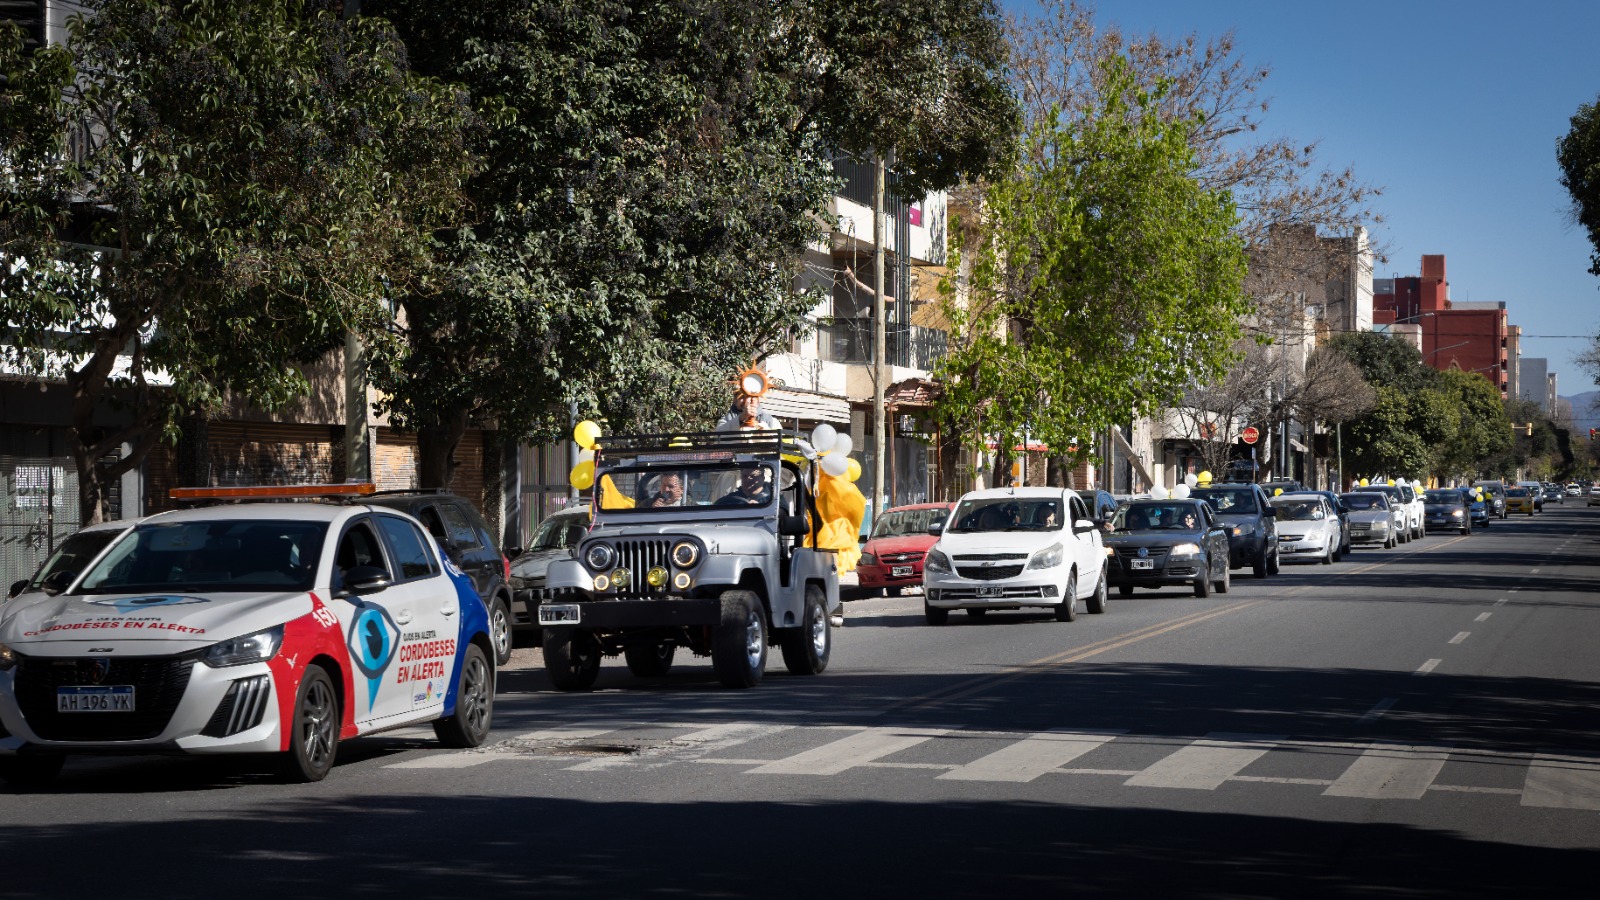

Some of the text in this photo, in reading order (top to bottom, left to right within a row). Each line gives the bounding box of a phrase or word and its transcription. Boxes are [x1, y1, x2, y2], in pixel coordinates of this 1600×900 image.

[312, 606, 337, 628] 150
[23, 621, 206, 637] CORDOBESES EN ALERTA
[403, 632, 414, 642] OJOS
[421, 630, 437, 640] ALERTA
[399, 639, 455, 662] CORDOBESES
[396, 661, 444, 684] EN ALERTA
[61, 694, 131, 710] AH 196 YK
